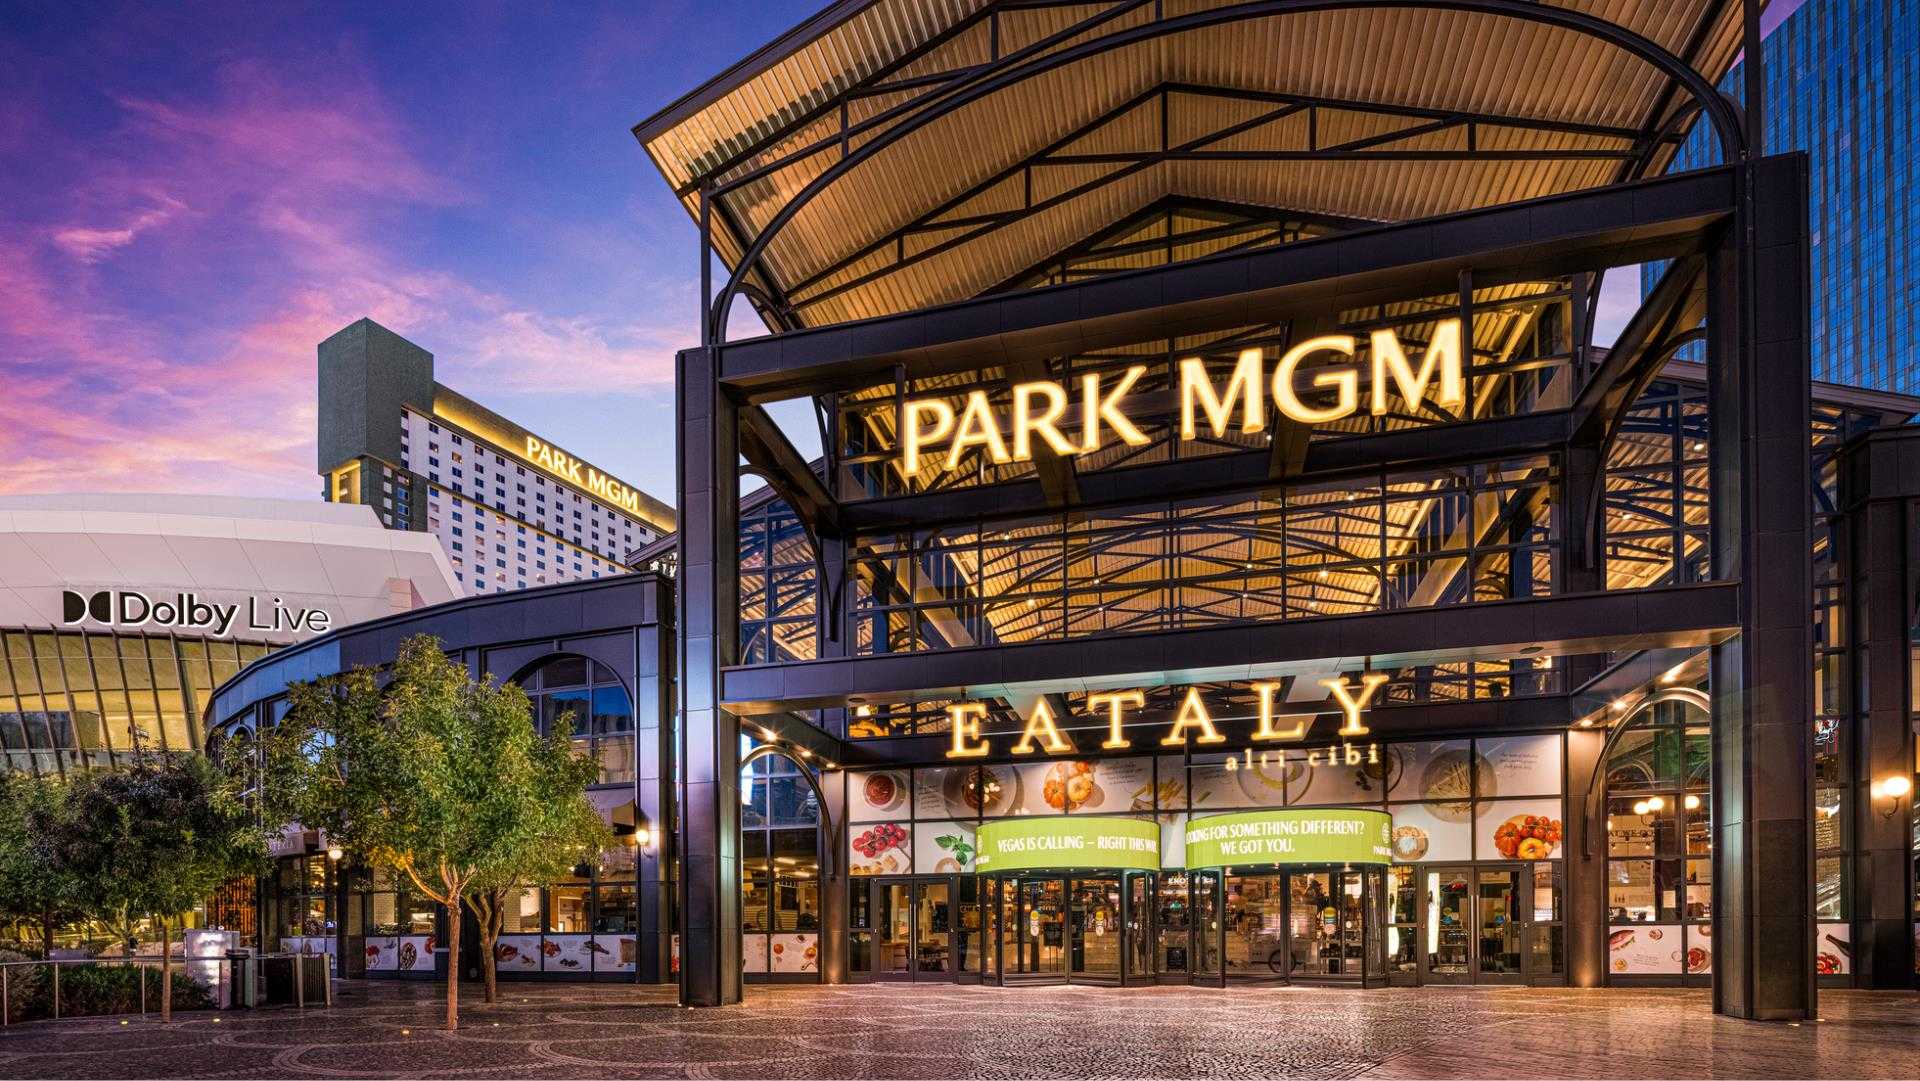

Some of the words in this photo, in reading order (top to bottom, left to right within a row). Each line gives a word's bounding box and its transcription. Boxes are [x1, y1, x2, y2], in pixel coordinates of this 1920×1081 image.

[904, 365, 1151, 476] PARK
[1179, 319, 1464, 441] MGM
[526, 436, 583, 484] PARK
[588, 468, 639, 512] MGM
[119, 591, 240, 637] Dolby
[249, 596, 332, 632] Live
[945, 674, 1390, 759] EATALY
[1225, 748, 1286, 771] alti
[1308, 743, 1379, 767] cibi
[997, 837, 1025, 853] VEGAS
[1026, 837, 1036, 850] IS
[1037, 835, 1084, 850] CALLING
[1097, 836, 1128, 850] RIGHT
[1209, 824, 1228, 839] FOR
[1229, 821, 1299, 837] SOMETHING
[1301, 820, 1365, 835] DIFFERENT?
[1220, 841, 1237, 856] WE
[1239, 839, 1263, 854] GOT
[1265, 838, 1295, 853] YOU.
